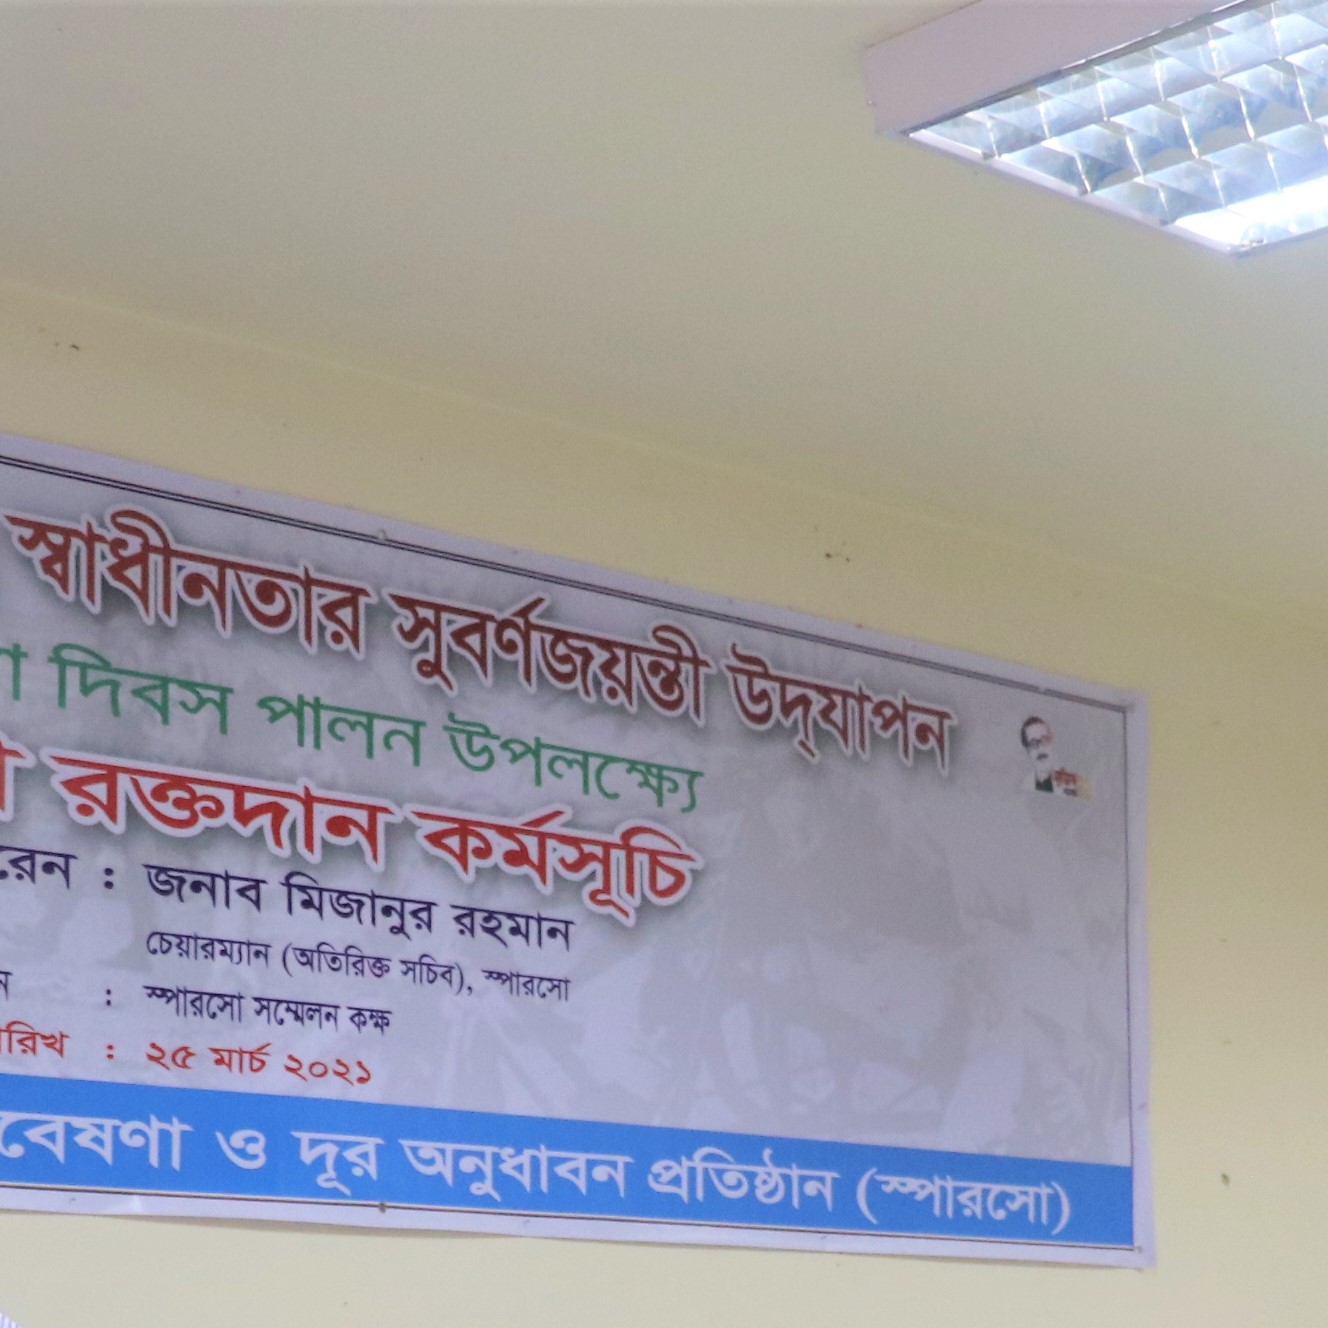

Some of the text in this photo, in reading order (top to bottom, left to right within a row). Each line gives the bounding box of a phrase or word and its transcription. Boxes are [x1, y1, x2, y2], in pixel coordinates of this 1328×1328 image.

[9, 511, 370, 650] স্বাধীনতার
[47, 642, 232, 733] দিবস
[258, 692, 424, 767] পালন
[56, 755, 394, 863] রক্তদান
[412, 810, 698, 919] কর্মসূচি
[142, 864, 268, 911] জনাব
[284, 872, 437, 941] মিজানুর
[451, 904, 575, 951] রহমান
[144, 985, 243, 1023] স্পারসো
[253, 997, 340, 1027] সম্মেলন
[348, 1008, 393, 1036] কক্ষ
[482, 969, 570, 1001] স্পারসো
[145, 1041, 196, 1071] ২৫
[209, 1043, 271, 1075] মার্চ
[284, 1053, 373, 1085] ২০২১
[215, 1128, 267, 1171] ও
[291, 1129, 384, 1195] দূর
[398, 1138, 634, 1202] অনুধাবন
[648, 1146, 840, 1211] প্রতিষ্ঠান
[855, 1167, 1071, 1235] (স্পারসো)
